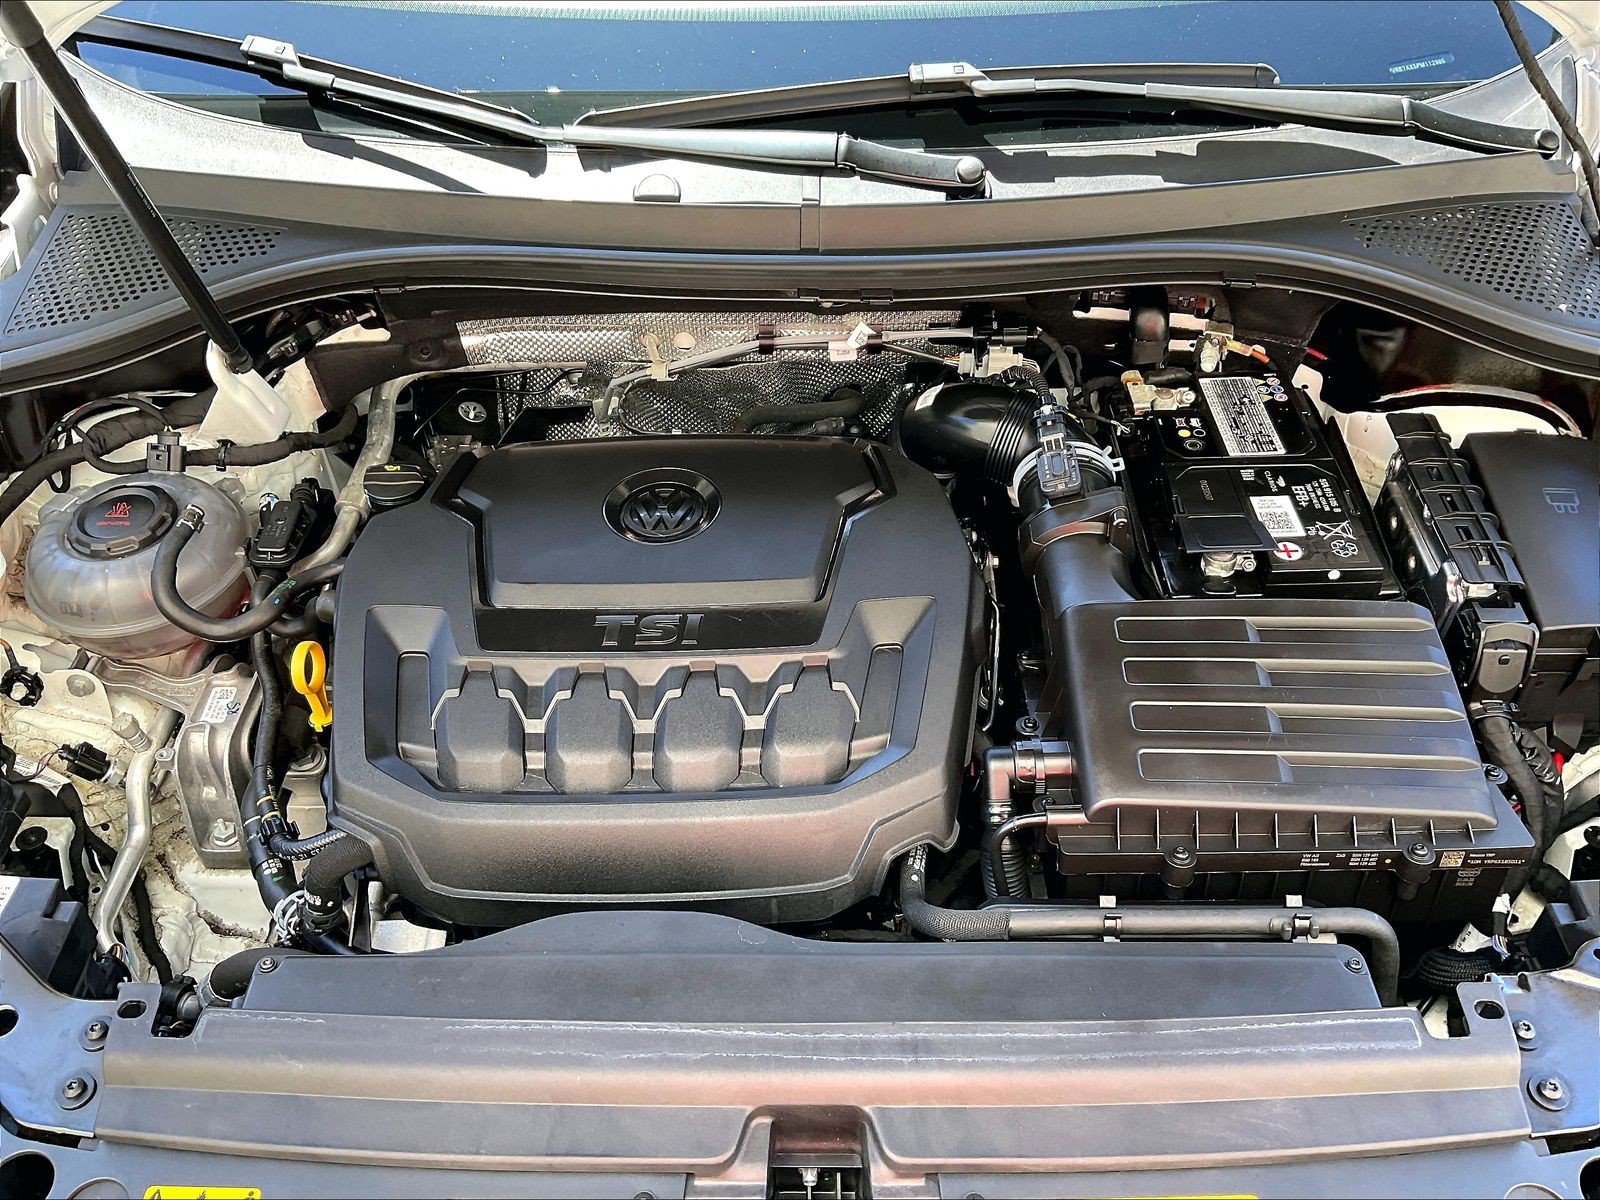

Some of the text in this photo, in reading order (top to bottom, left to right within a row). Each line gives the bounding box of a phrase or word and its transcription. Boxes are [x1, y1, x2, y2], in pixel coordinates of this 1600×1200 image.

[1264, 470, 1278, 493] CLARIOS
[1291, 485, 1310, 508] EFB+
[592, 613, 705, 647] TSI
